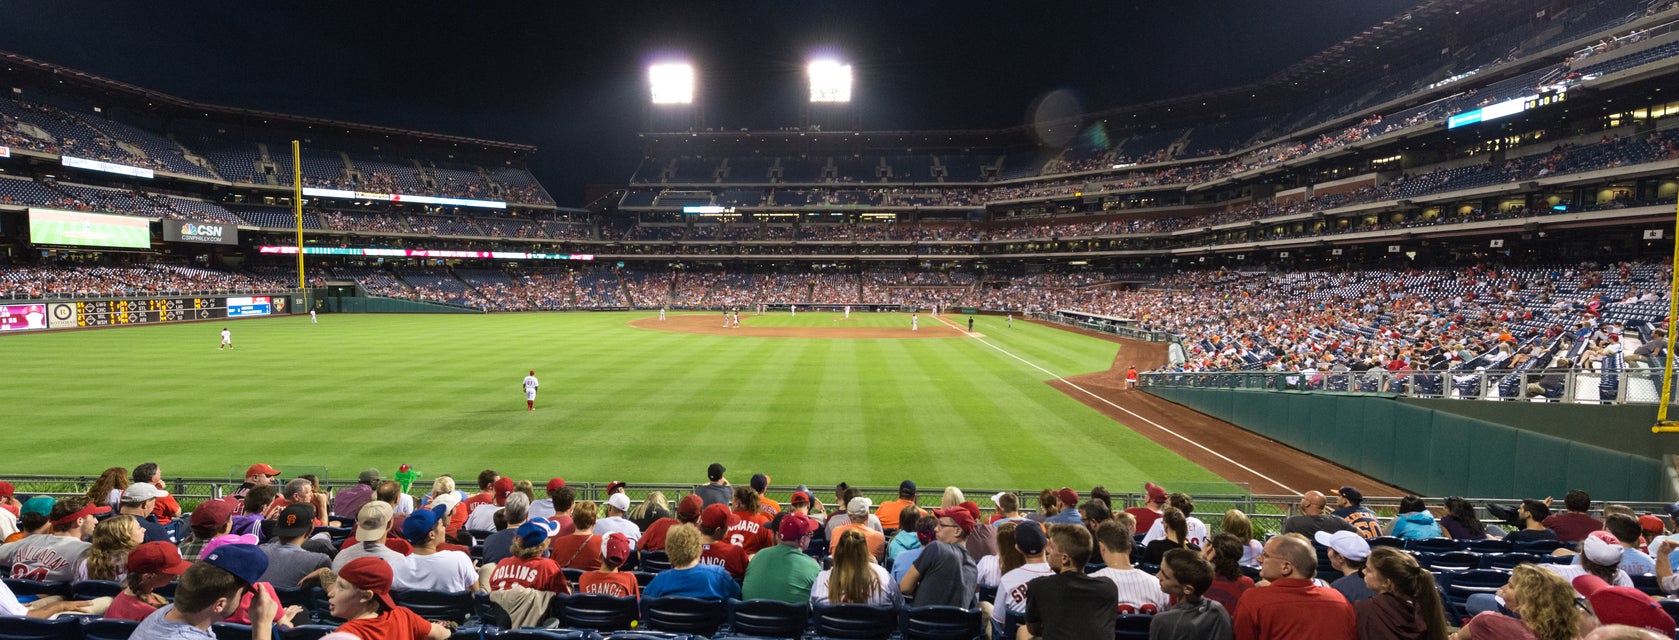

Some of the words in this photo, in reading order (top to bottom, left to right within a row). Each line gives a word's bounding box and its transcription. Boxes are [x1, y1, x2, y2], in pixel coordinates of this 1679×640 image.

[197, 224, 222, 236] CSN
[728, 520, 760, 534] WARD
[493, 564, 538, 582] ROLLINS
[586, 583, 622, 598] FRANCO
